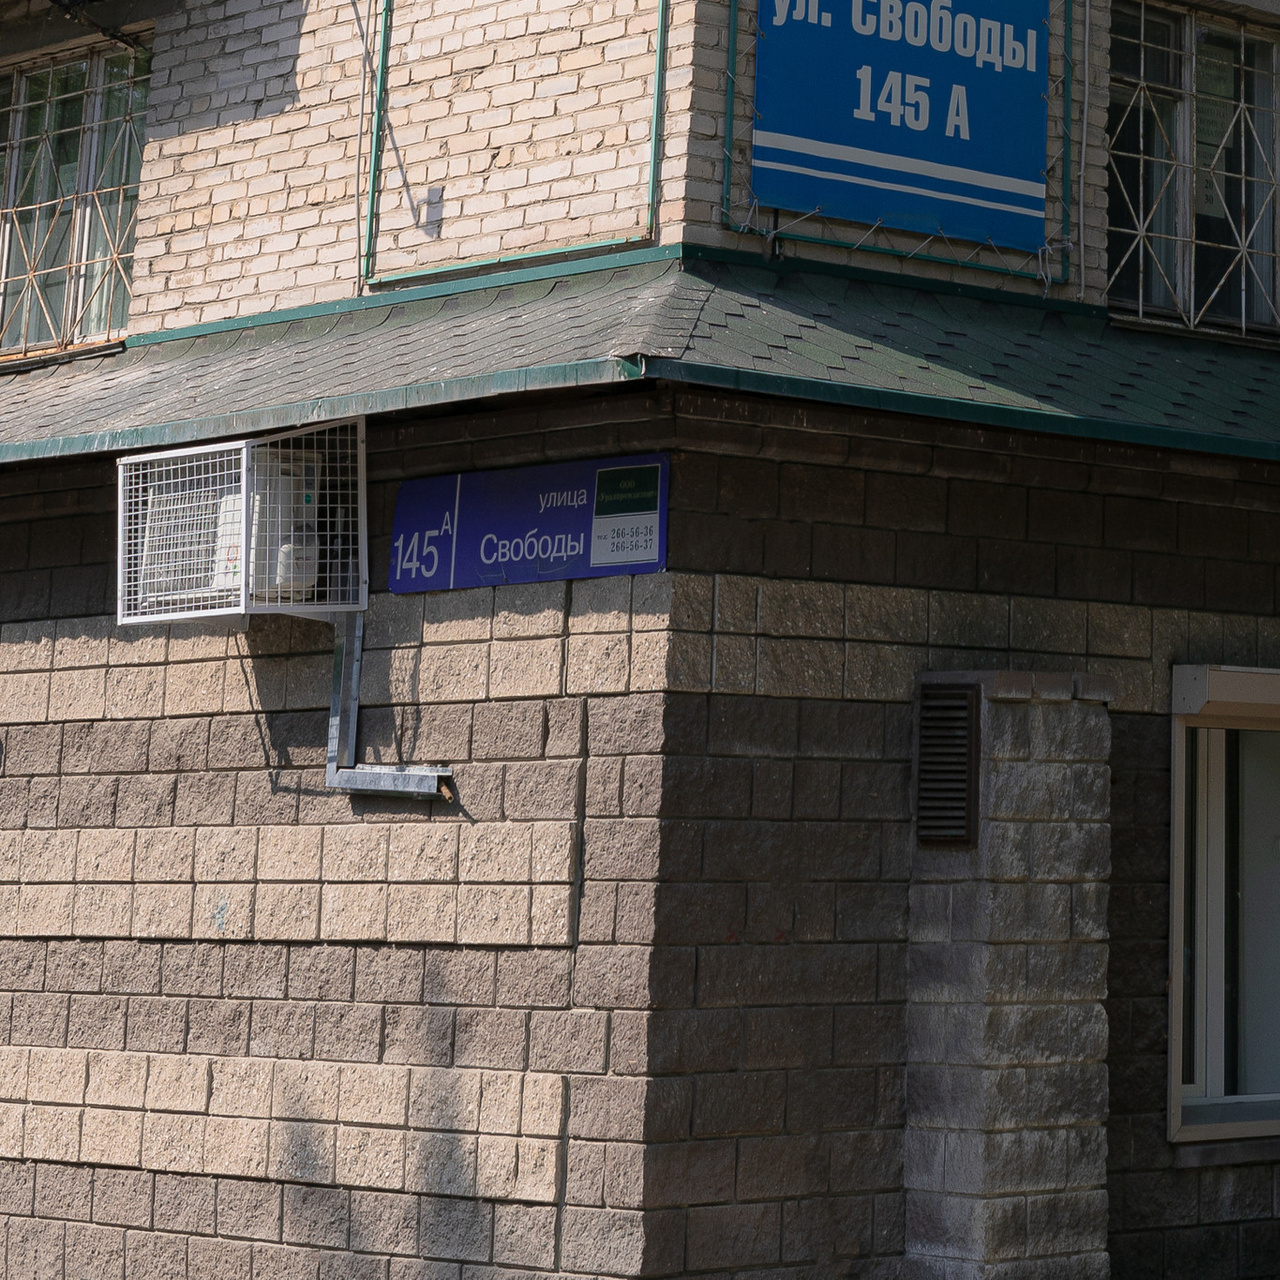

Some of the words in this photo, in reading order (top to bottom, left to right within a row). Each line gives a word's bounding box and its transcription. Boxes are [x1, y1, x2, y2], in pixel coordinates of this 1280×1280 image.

[853, 64, 931, 131] 145
[945, 83, 970, 141] А
[539, 489, 587, 513] улица
[610, 525, 654, 539] 266-56-36
[479, 528, 585, 564] Свободы
[610, 538, 654, 553] 266-56-37
